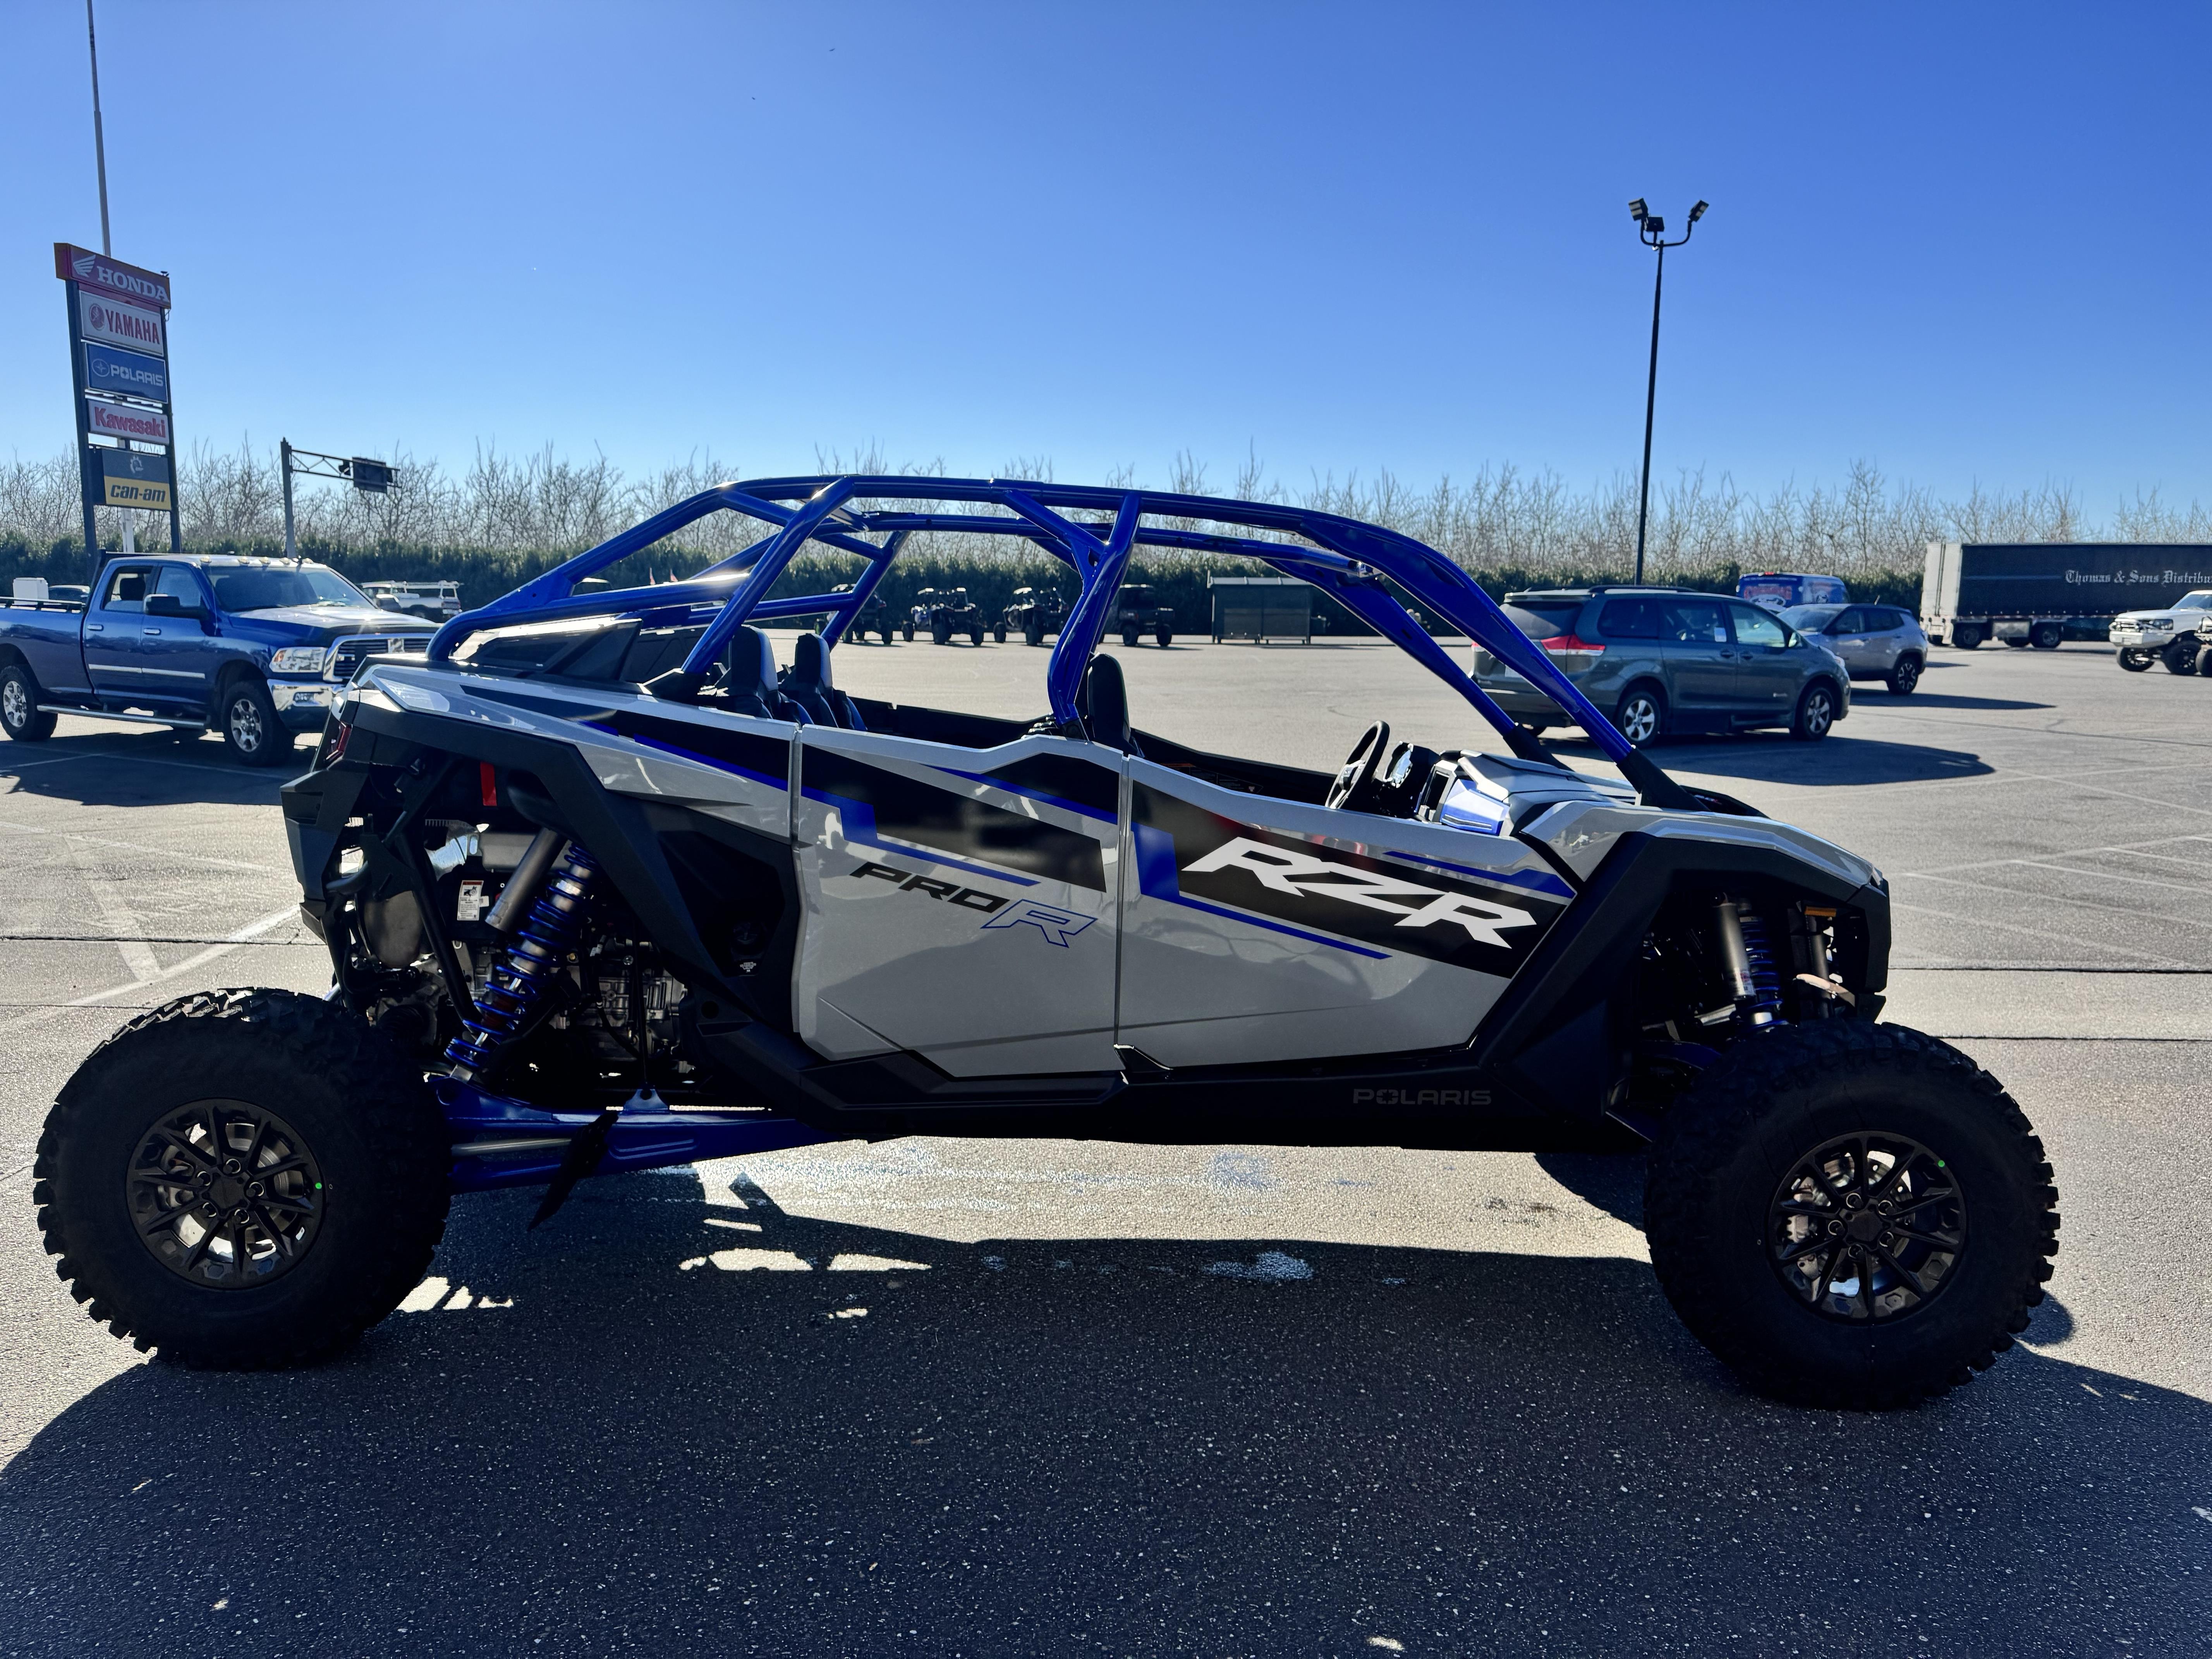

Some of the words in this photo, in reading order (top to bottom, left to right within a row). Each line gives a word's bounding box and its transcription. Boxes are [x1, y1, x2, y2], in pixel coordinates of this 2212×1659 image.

[97, 266, 170, 302] HONDA
[105, 309, 160, 345] YAMAHA
[110, 364, 163, 387] POLARIS
[94, 407, 166, 438] Kawasaki
[111, 484, 166, 502] can-am
[2065, 569, 2111, 586] Thomas
[2114, 570, 2126, 583] &
[2126, 569, 2159, 586] Sons
[850, 862, 1010, 913] PRO
[980, 898, 1098, 948] R
[1181, 836, 1537, 949] RZR
[1353, 1089, 1491, 1105] POLARIS
